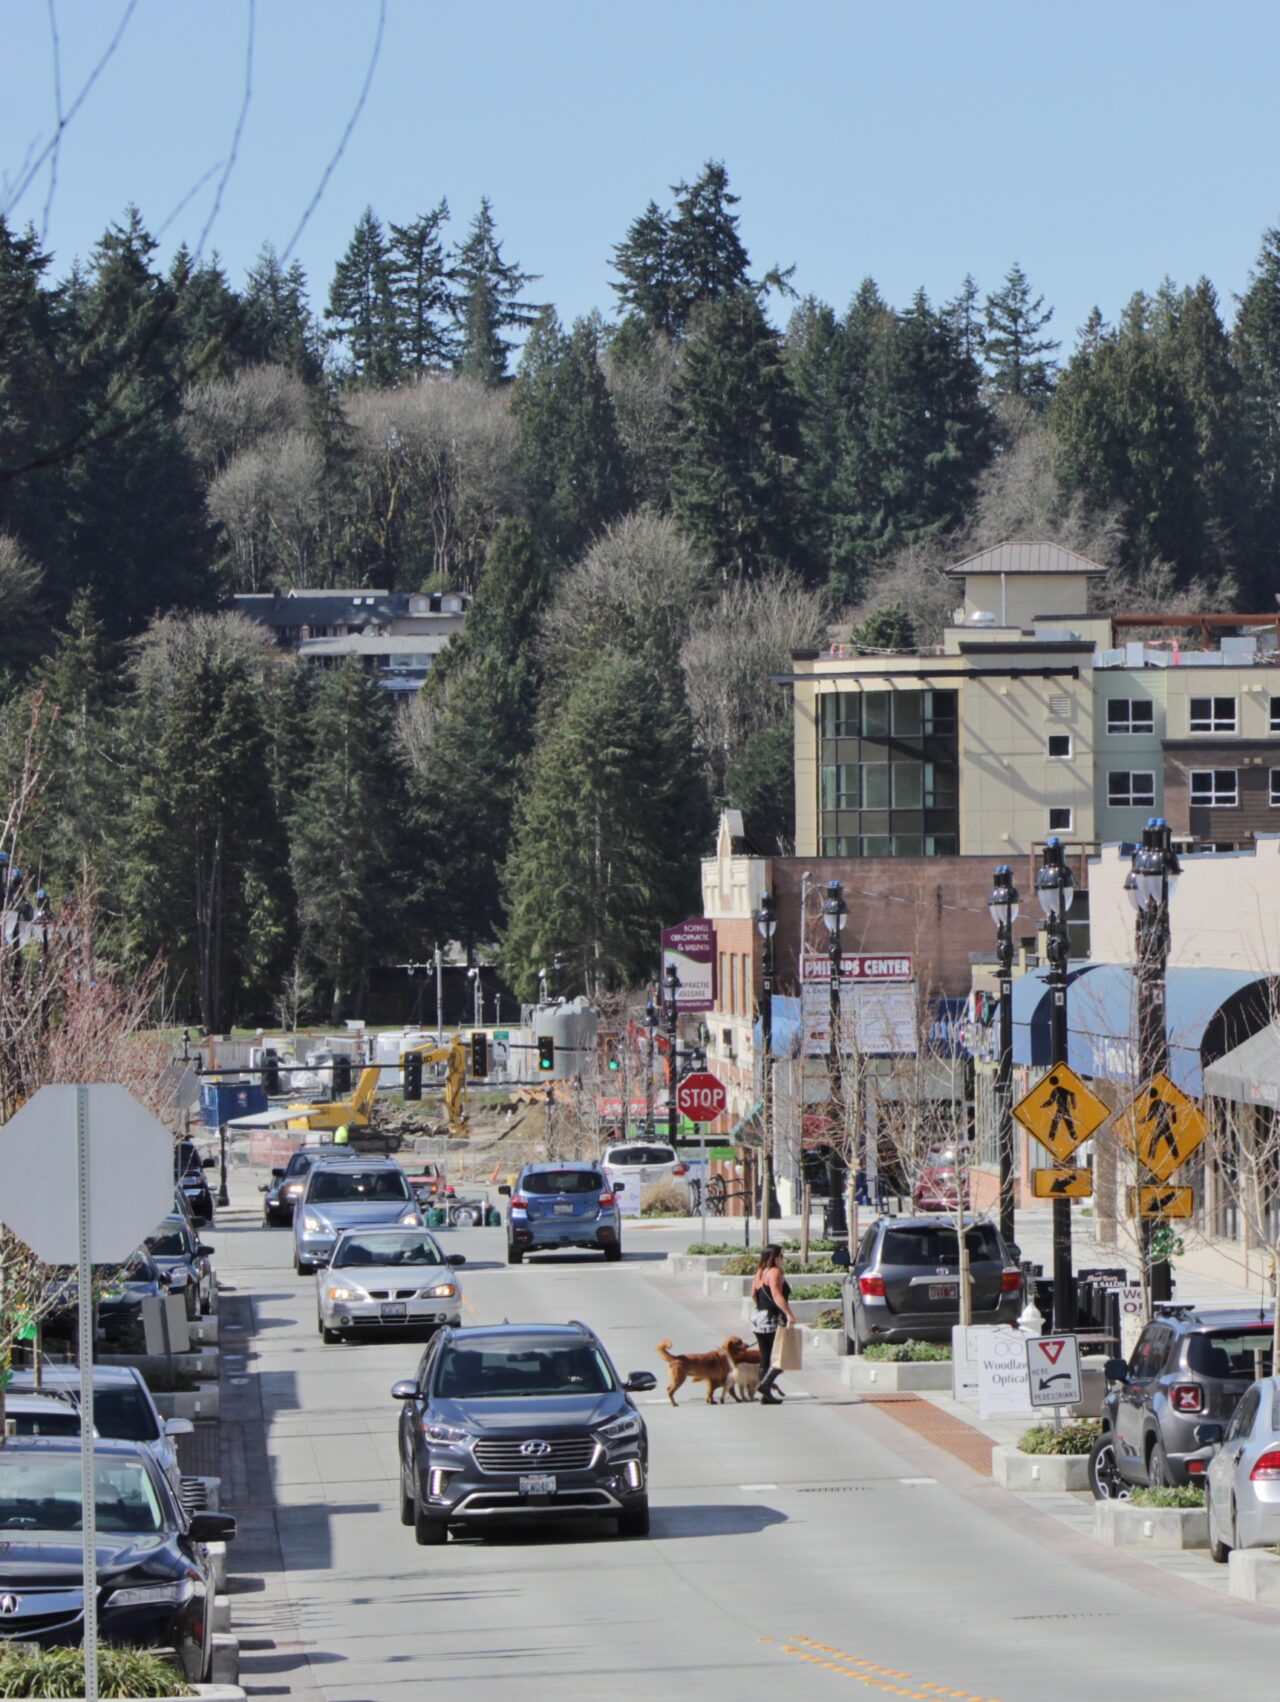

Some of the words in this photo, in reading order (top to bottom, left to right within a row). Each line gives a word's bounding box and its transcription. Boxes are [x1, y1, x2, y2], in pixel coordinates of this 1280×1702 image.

[863, 960, 910, 974] CENTER
[681, 1089, 723, 1107] STOP
[1032, 1368, 1049, 1376] HERE
